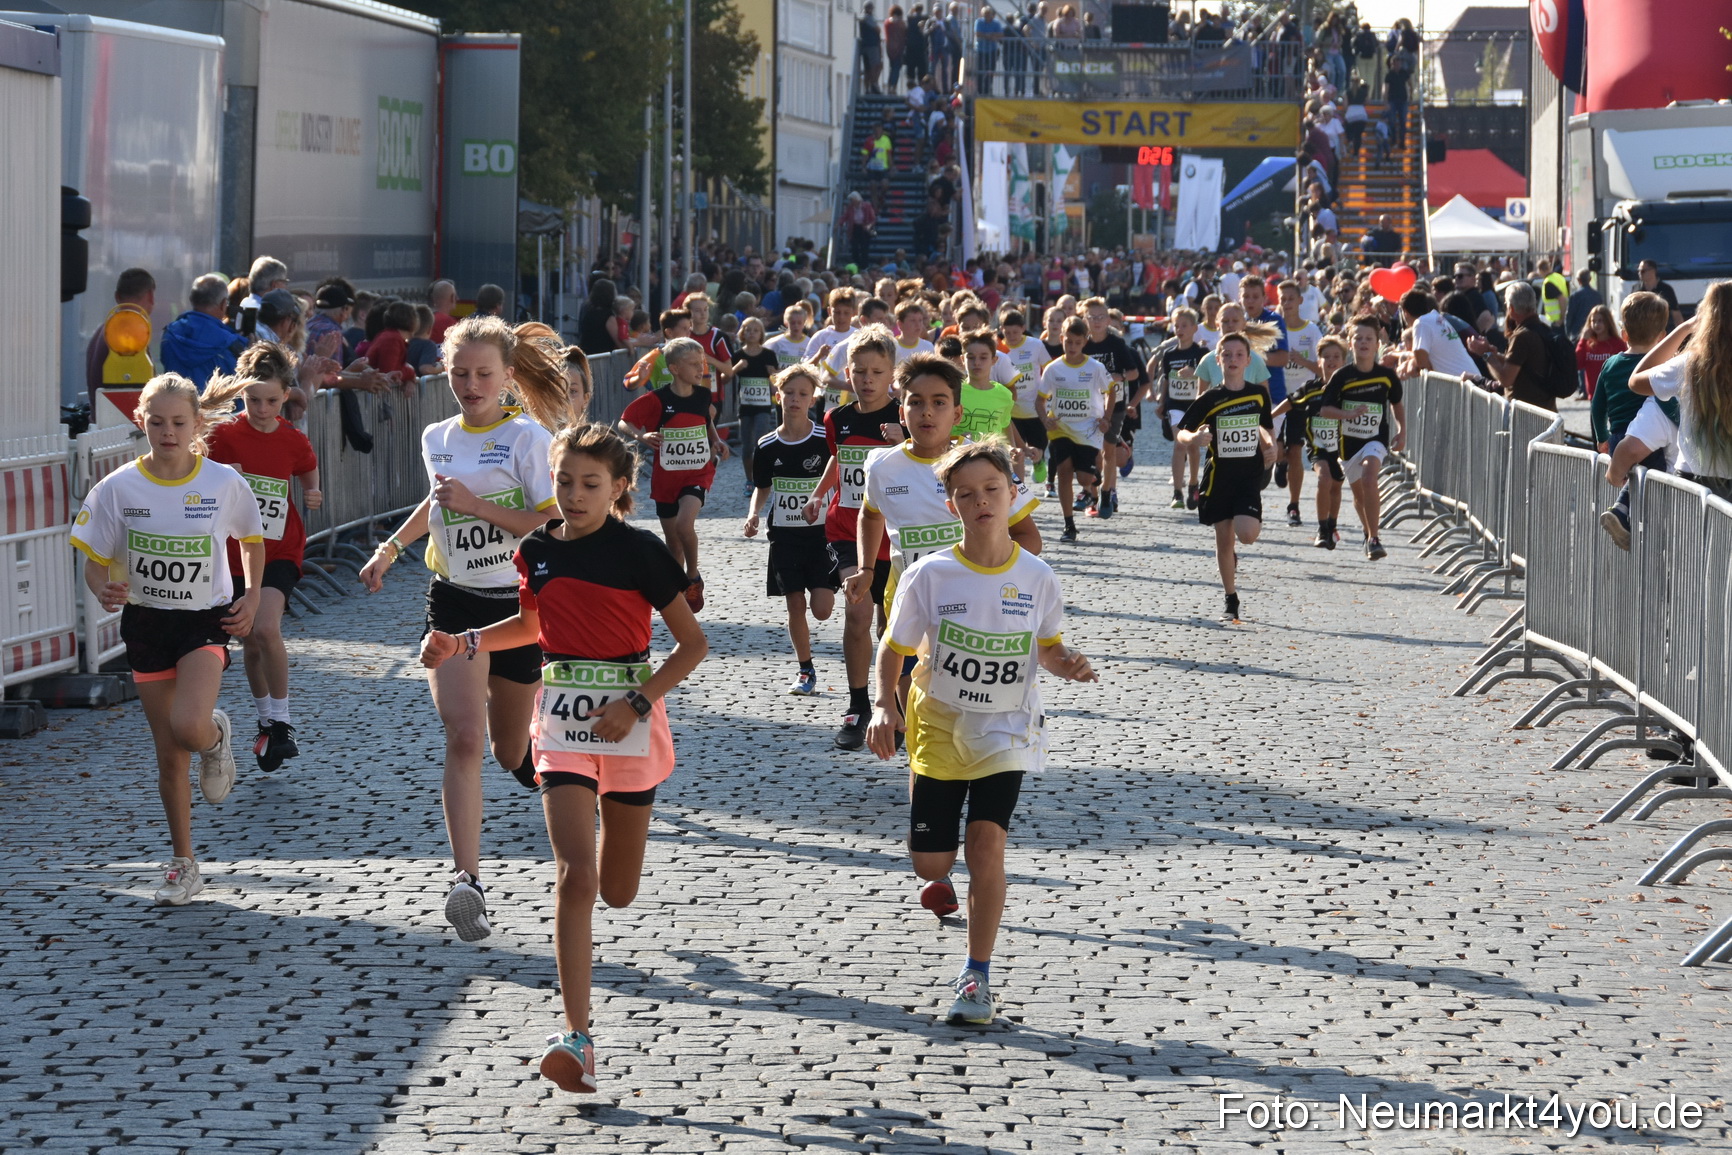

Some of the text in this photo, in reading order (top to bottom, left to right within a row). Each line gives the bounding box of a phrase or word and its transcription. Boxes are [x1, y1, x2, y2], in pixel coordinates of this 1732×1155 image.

[1081, 110, 1193, 137] START
[377, 101, 422, 185] BOCK
[1654, 153, 1732, 169] BOCK
[1585, 351, 1610, 361] Femm
[1171, 380, 1196, 390] 4021
[743, 387, 767, 396] 4037
[1057, 390, 1087, 398] BOCK
[1057, 400, 1088, 411] 4006
[1219, 416, 1258, 427] BOCK
[1345, 414, 1378, 427] 4036
[664, 428, 705, 440] BOCK
[1222, 429, 1257, 443] 4035
[666, 441, 705, 456] 4045
[665, 458, 706, 466] JONATHAN
[246, 476, 283, 496] OCK
[777, 479, 819, 490] BOCK
[885, 486, 909, 494] BOCK
[185, 494, 200, 505] 20
[124, 508, 150, 516] BOCK
[133, 532, 205, 556] BOCK
[466, 549, 516, 571] ANNIKA
[135, 556, 203, 584] 4007
[142, 585, 194, 600] CECILIA
[1002, 587, 1018, 599] 20
[938, 603, 967, 612] BOCK
[1001, 600, 1035, 609] Neumarkter
[1001, 608, 1029, 617] Stadtlauf
[945, 624, 1026, 654] BOCK
[942, 651, 1019, 686] 4038
[551, 665, 642, 686] BOCK
[958, 688, 994, 704] PHIL
